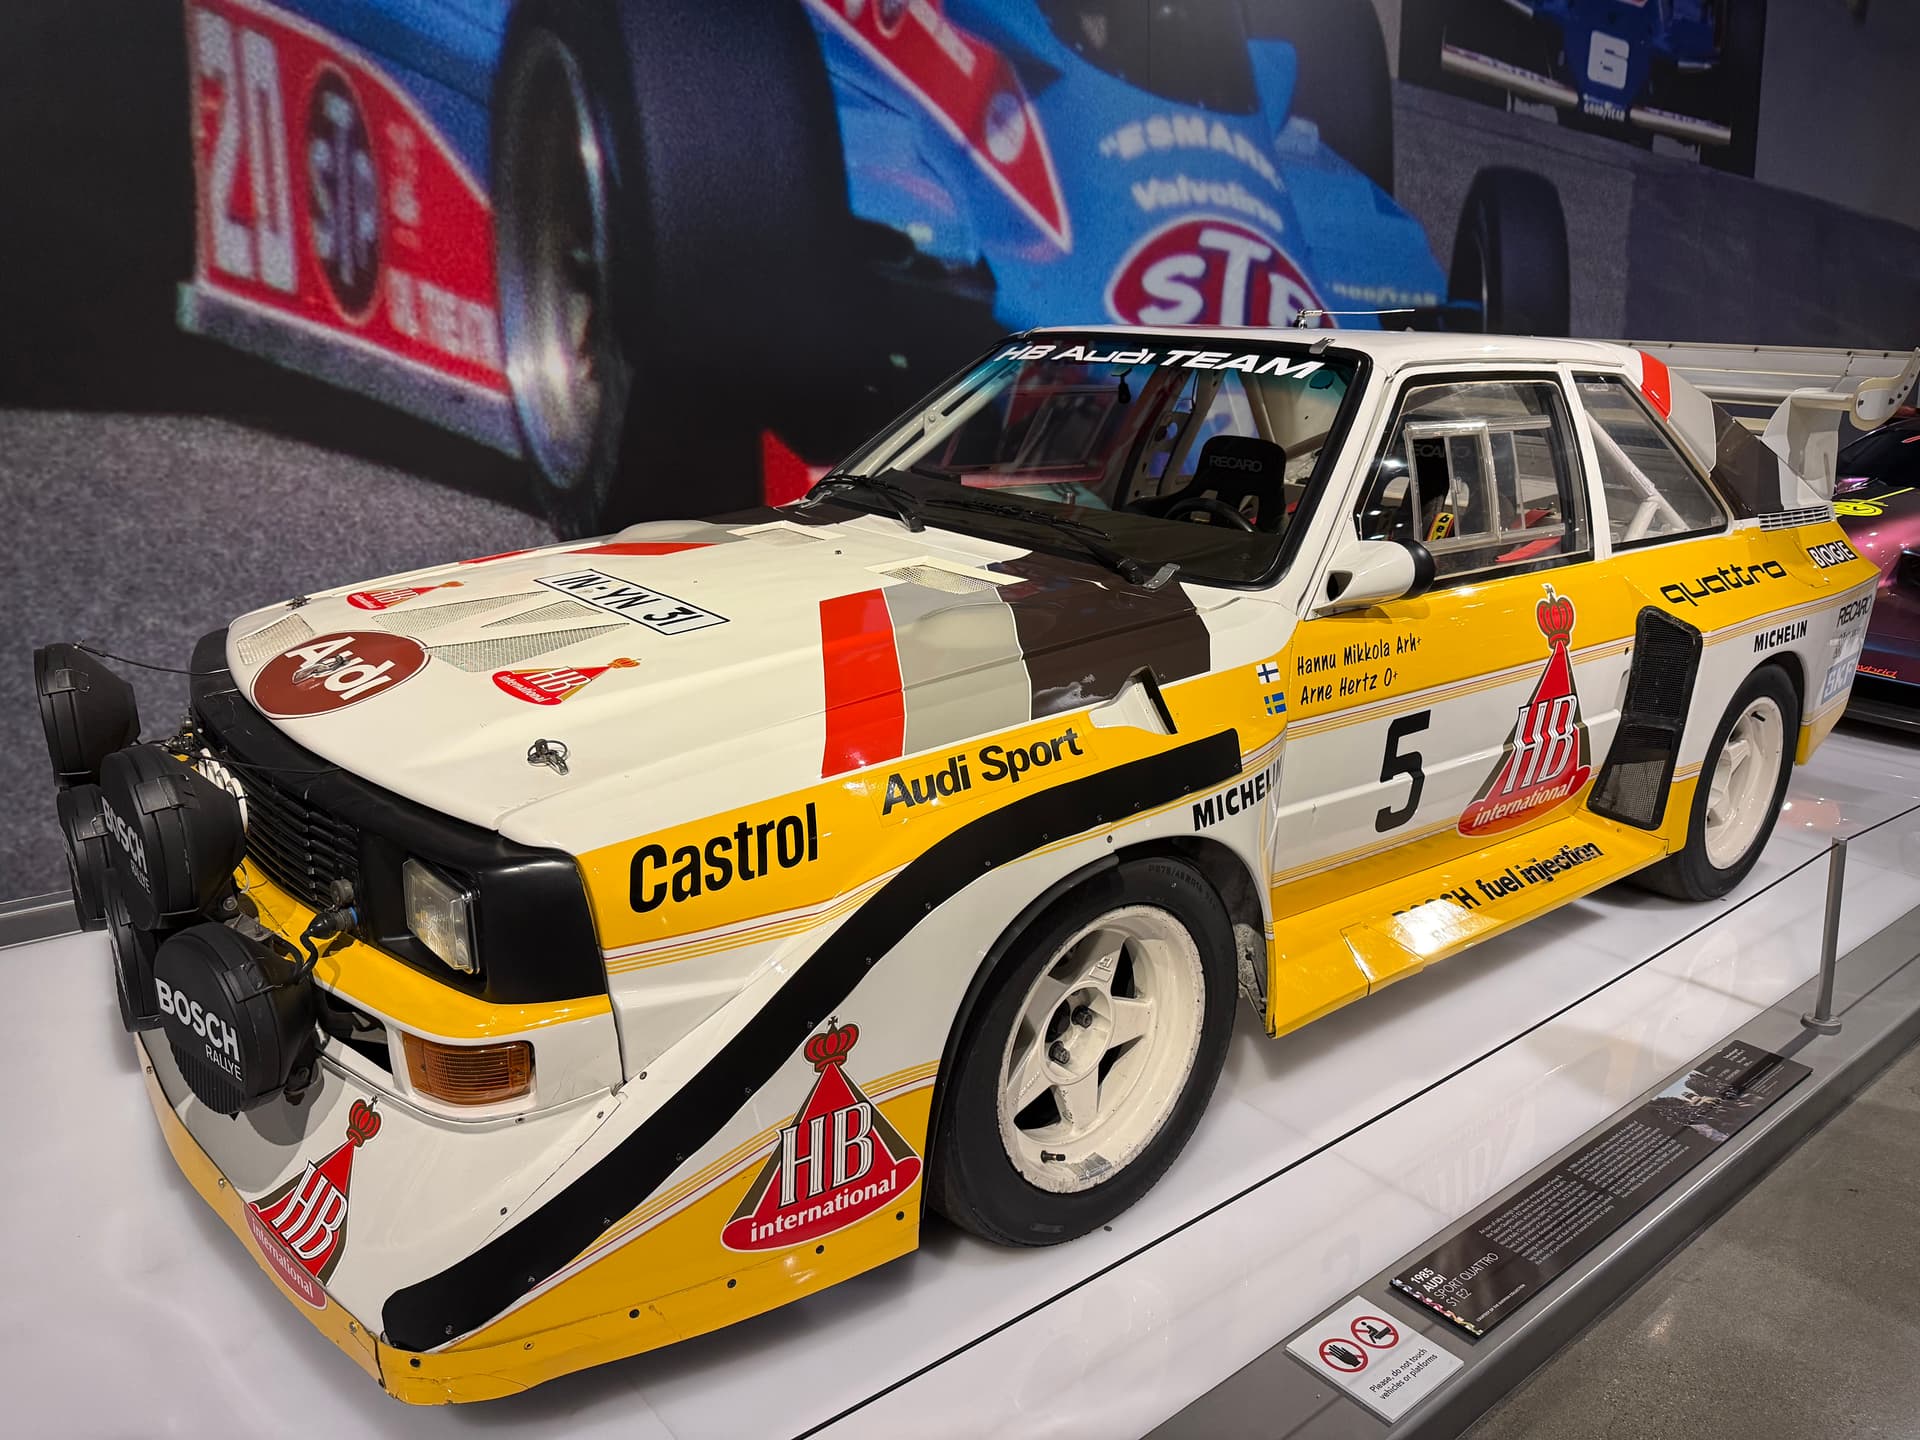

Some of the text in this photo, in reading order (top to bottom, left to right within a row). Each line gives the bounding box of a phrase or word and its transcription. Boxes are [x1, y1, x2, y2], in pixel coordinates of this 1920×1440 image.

[1587, 30, 1630, 90] 6
[196, 9, 297, 296] 20
[1137, 229, 1320, 328] STP
[993, 344, 1326, 379] HB Audi TEAM
[1209, 455, 1263, 473] RECARO
[1807, 541, 1857, 569] BOGE
[1660, 560, 1787, 607] quattro
[1837, 595, 1873, 628] RECARO
[1297, 653, 1337, 677] Hannu
[1343, 638, 1390, 666] Mikkola
[1753, 620, 1808, 653] MICHELIN
[497, 675, 554, 703] international
[523, 666, 592, 692] HB
[1300, 684, 1333, 706] Arne
[1339, 672, 1378, 697] Hertz
[1502, 692, 1578, 795] HB
[881, 727, 1084, 816] Audi Sport
[1375, 709, 1432, 833] 5
[1471, 775, 1576, 829] international
[102, 796, 148, 875] BOSCH
[629, 802, 818, 914] Castrol
[1475, 842, 1605, 901] fuel injection
[155, 977, 240, 1063] BOSCH
[205, 1044, 243, 1082] RALLYE
[776, 1101, 874, 1210] HB
[271, 1159, 348, 1261] HB
[751, 1168, 897, 1243] international
[251, 1217, 315, 1299] international
[1410, 1267, 1434, 1284] 1985
[1433, 1252, 1499, 1300] SPORT QUATTRO
[1422, 1274, 1448, 1293] AUDI
[1445, 1288, 1472, 1307] S1 E2
[1369, 1348, 1428, 1393] Please, do not touch
[1380, 1353, 1438, 1400] vehicles or platforms
